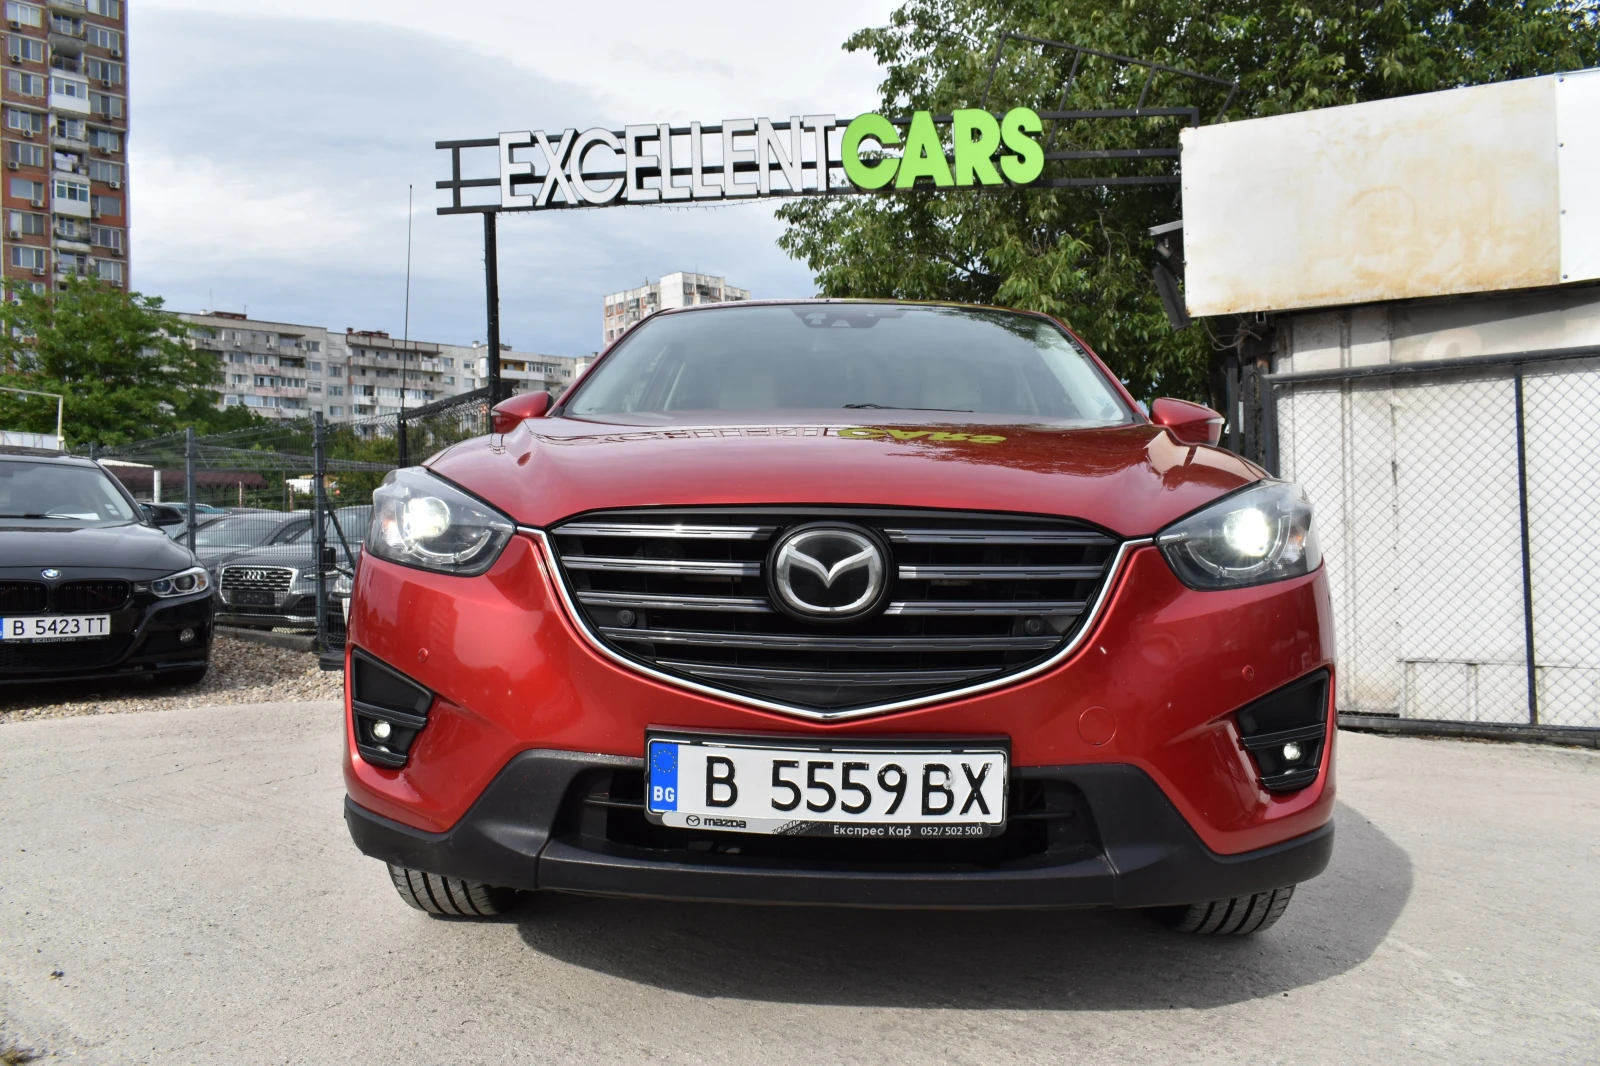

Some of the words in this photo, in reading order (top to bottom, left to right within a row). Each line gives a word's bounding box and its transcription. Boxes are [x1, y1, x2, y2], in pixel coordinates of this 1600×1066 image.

[499, 113, 836, 208] EXCELLENT
[841, 106, 1045, 190] CARS
[13, 620, 25, 636] B
[35, 618, 80, 635] 5423
[85, 617, 107, 633] TT
[653, 785, 675, 803] BG
[706, 755, 739, 808] B
[771, 759, 908, 816] 5559
[921, 762, 993, 816] BX
[833, 824, 885, 837] Експрес
[888, 825, 912, 837] Кар
[945, 826, 963, 835] 502
[964, 826, 983, 835] 500
